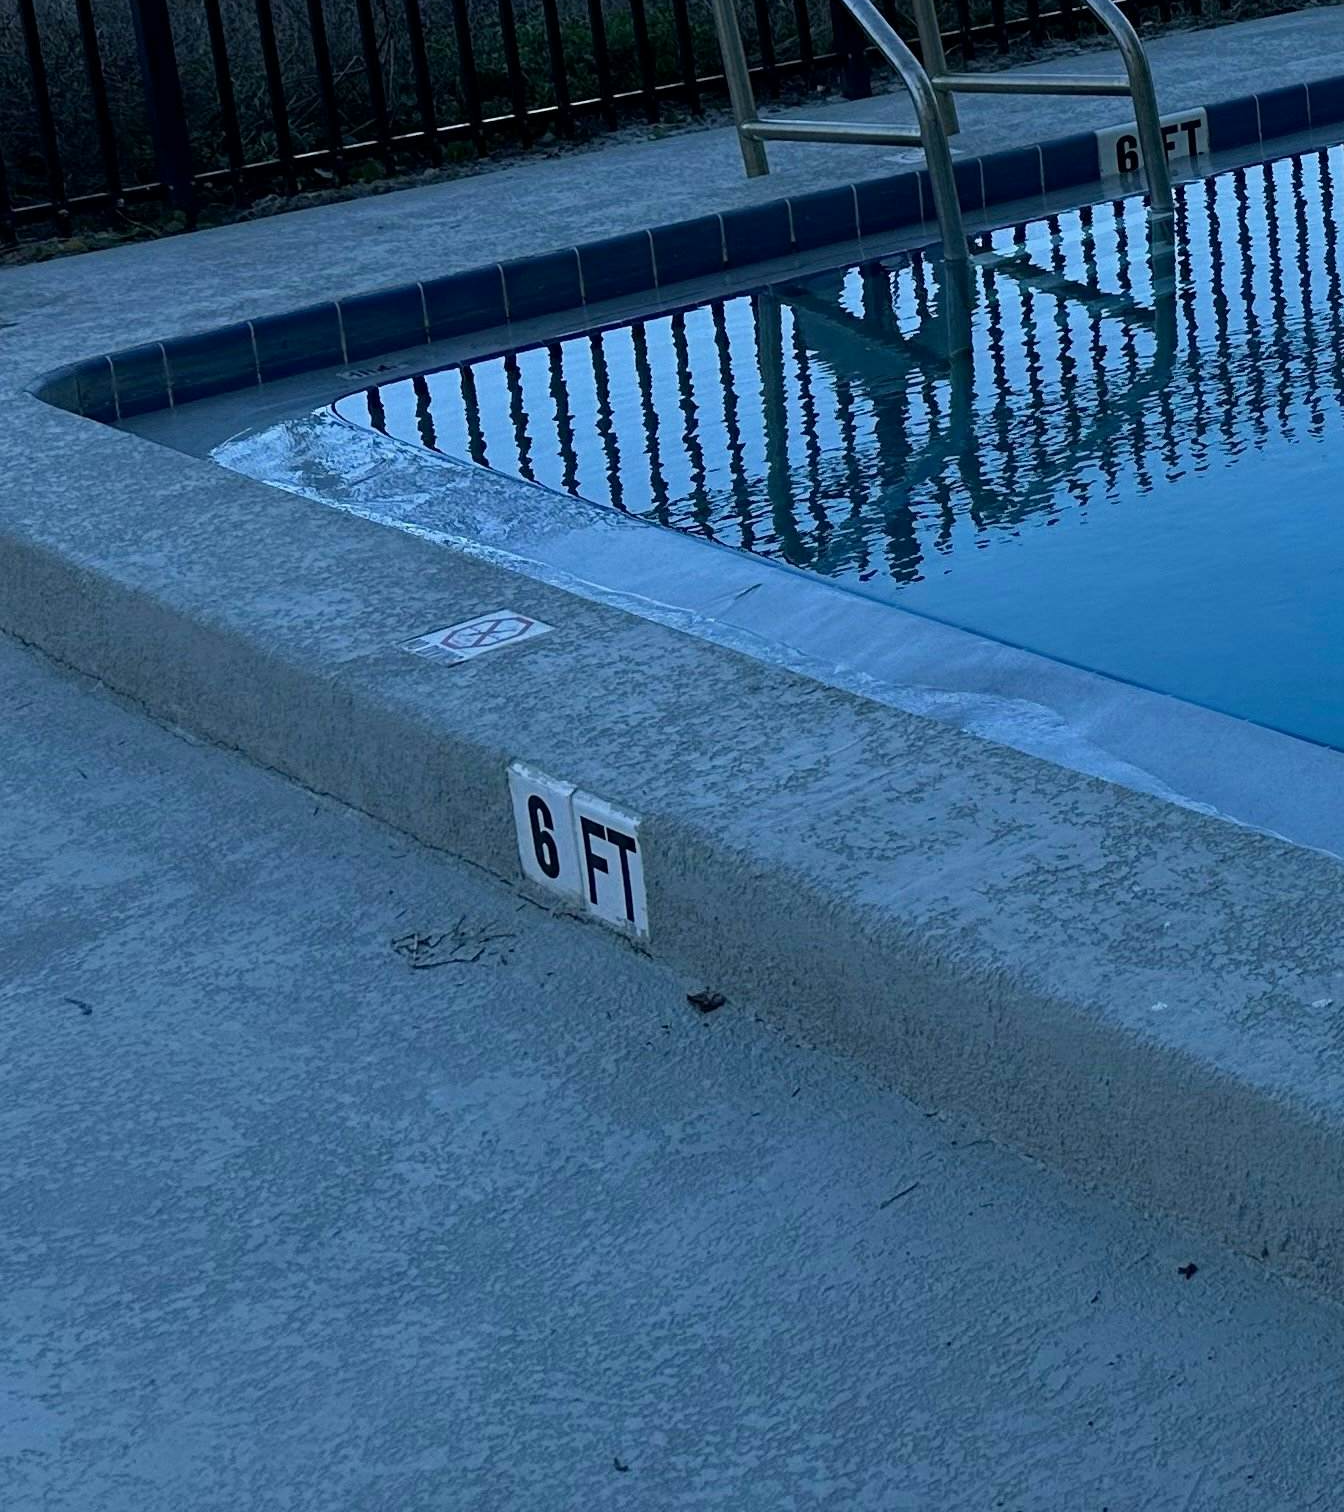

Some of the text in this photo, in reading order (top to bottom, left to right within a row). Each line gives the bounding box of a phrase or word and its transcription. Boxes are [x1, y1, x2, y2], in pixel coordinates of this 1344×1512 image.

[1116, 118, 1202, 174] 6 FT
[527, 794, 637, 923] 6 FT
